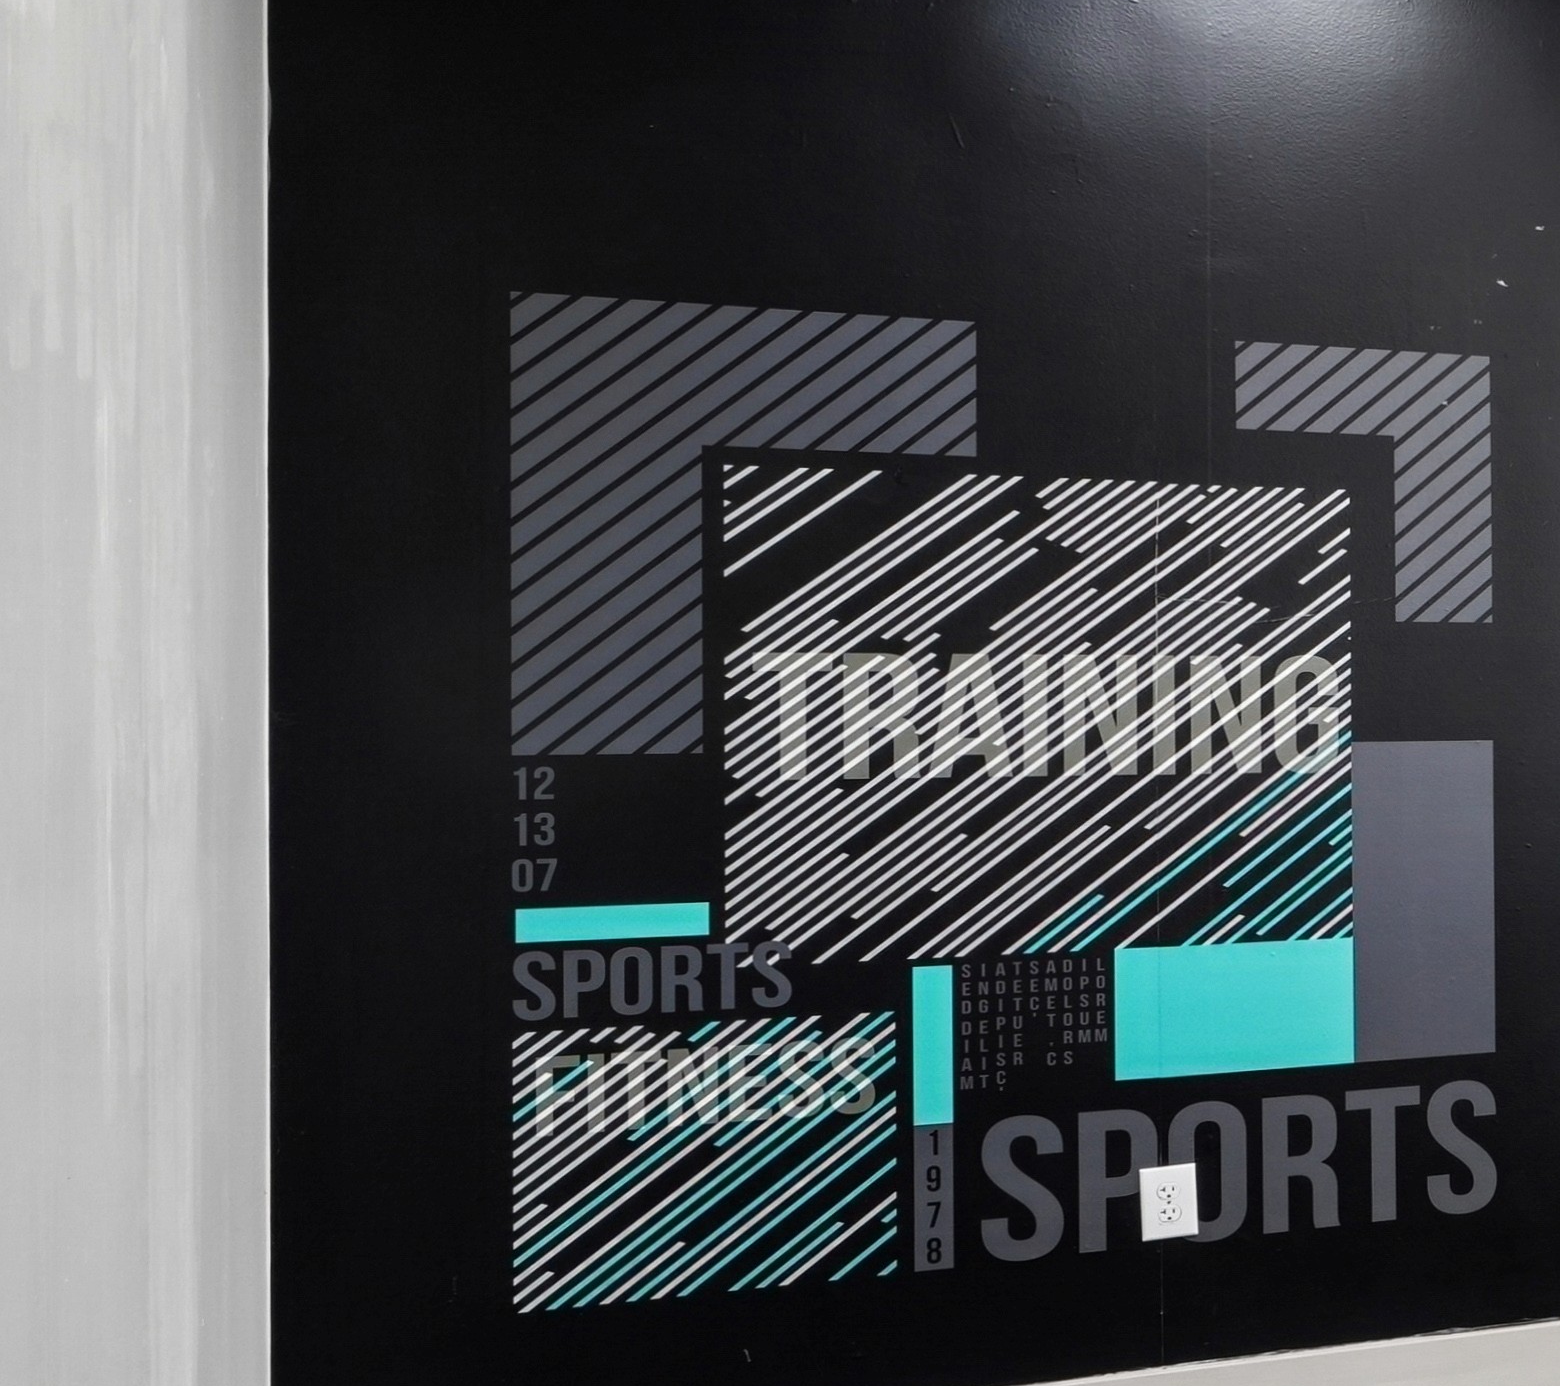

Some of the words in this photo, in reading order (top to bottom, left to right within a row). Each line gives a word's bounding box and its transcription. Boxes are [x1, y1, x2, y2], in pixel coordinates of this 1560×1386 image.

[752, 652, 1341, 780] TRAINING
[513, 766, 555, 801] 12
[513, 812, 556, 847] 13
[511, 857, 558, 893] 07
[512, 941, 793, 1021] SPORTS
[535, 1037, 876, 1138] FITNESS
[926, 1129, 942, 1264] 1978
[981, 1079, 1498, 1262] SPORTS
